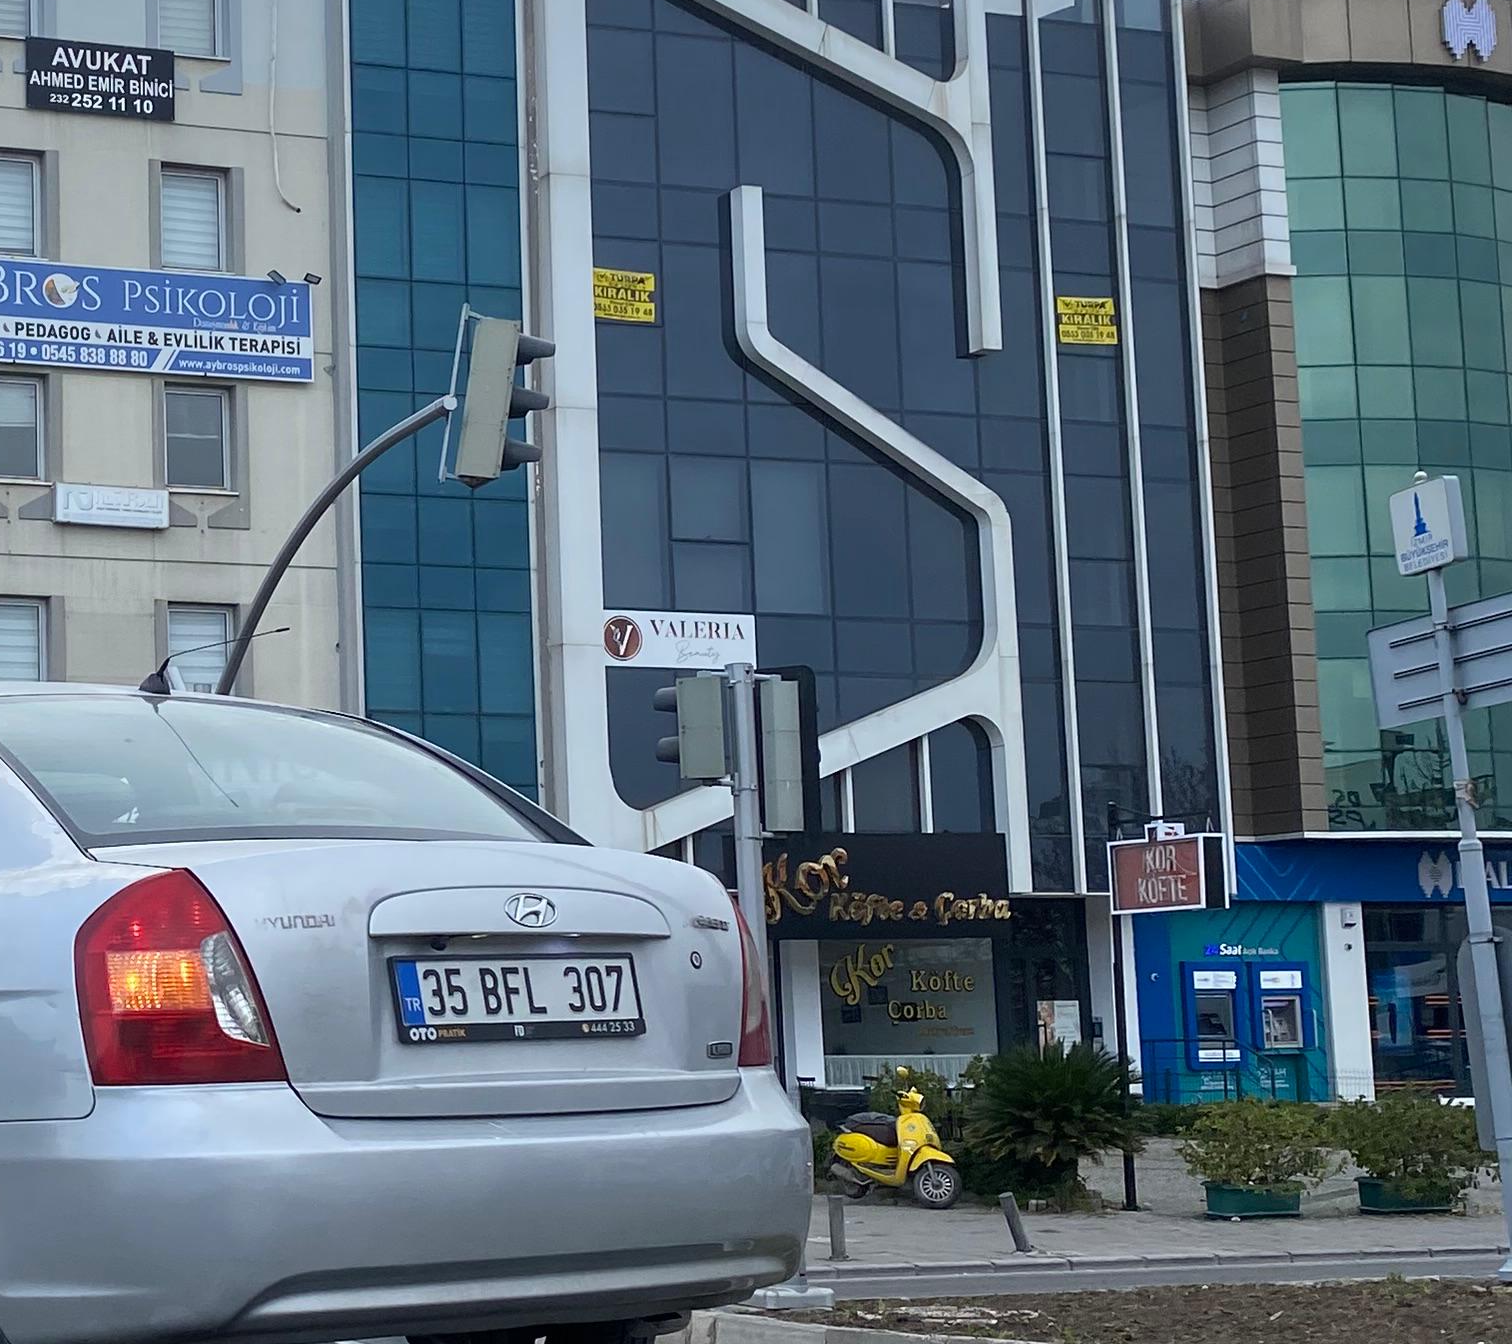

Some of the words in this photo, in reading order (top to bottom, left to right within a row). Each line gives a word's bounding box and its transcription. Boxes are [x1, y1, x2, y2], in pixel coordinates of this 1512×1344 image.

[52, 46, 151, 75] AVUKAT
[29, 70, 84, 89] AHMED
[88, 74, 125, 94] EMİR
[130, 77, 173, 98] BİNİCİ
[50, 93, 69, 104] 232
[71, 93, 103, 109] 252
[109, 96, 126, 111] 11
[133, 99, 153, 114] 10
[15, 322, 90, 341] PEDAGOG
[107, 325, 142, 345] AİLE
[148, 333, 158, 346] &
[164, 330, 224, 351] EVLİLİK
[229, 336, 300, 356] TERAPİSİ
[9, 343, 26, 358] 19
[42, 344, 76, 361] 0545
[80, 347, 105, 363] 838
[109, 349, 127, 364] 88
[131, 350, 148, 366] 80
[179, 359, 300, 376] www.aybrospsikoloji.com
[649, 619, 745, 640] VALERIA
[1144, 844, 1177, 873] KOR
[1219, 944, 1242, 955] Saat
[830, 944, 894, 1005] Kor
[910, 969, 975, 992] Köfte
[422, 967, 469, 1016] 35
[481, 967, 548, 1015] BFL
[563, 965, 624, 1013] 307
[405, 996, 422, 1012] TR
[888, 1000, 948, 1025] Çorba
[410, 1027, 437, 1041] OTO
[591, 1023, 607, 1033] 444
[610, 1022, 621, 1032] 25
[623, 1021, 635, 1032] 33
